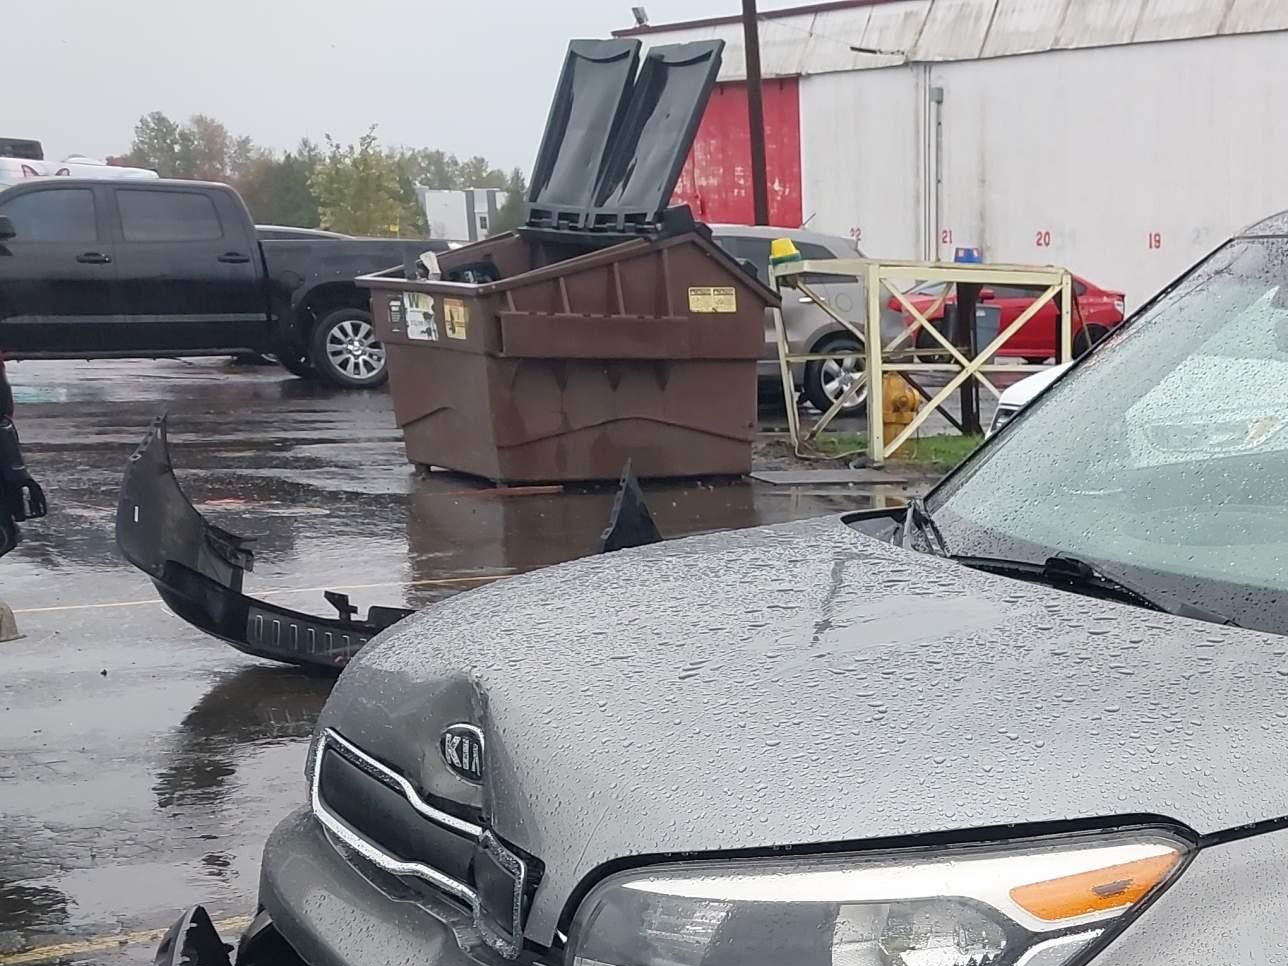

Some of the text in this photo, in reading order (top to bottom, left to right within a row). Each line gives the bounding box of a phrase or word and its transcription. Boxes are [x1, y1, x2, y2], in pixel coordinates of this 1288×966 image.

[941, 229, 953, 245] 21
[1035, 231, 1051, 247] 20
[1148, 232, 1162, 249] 19
